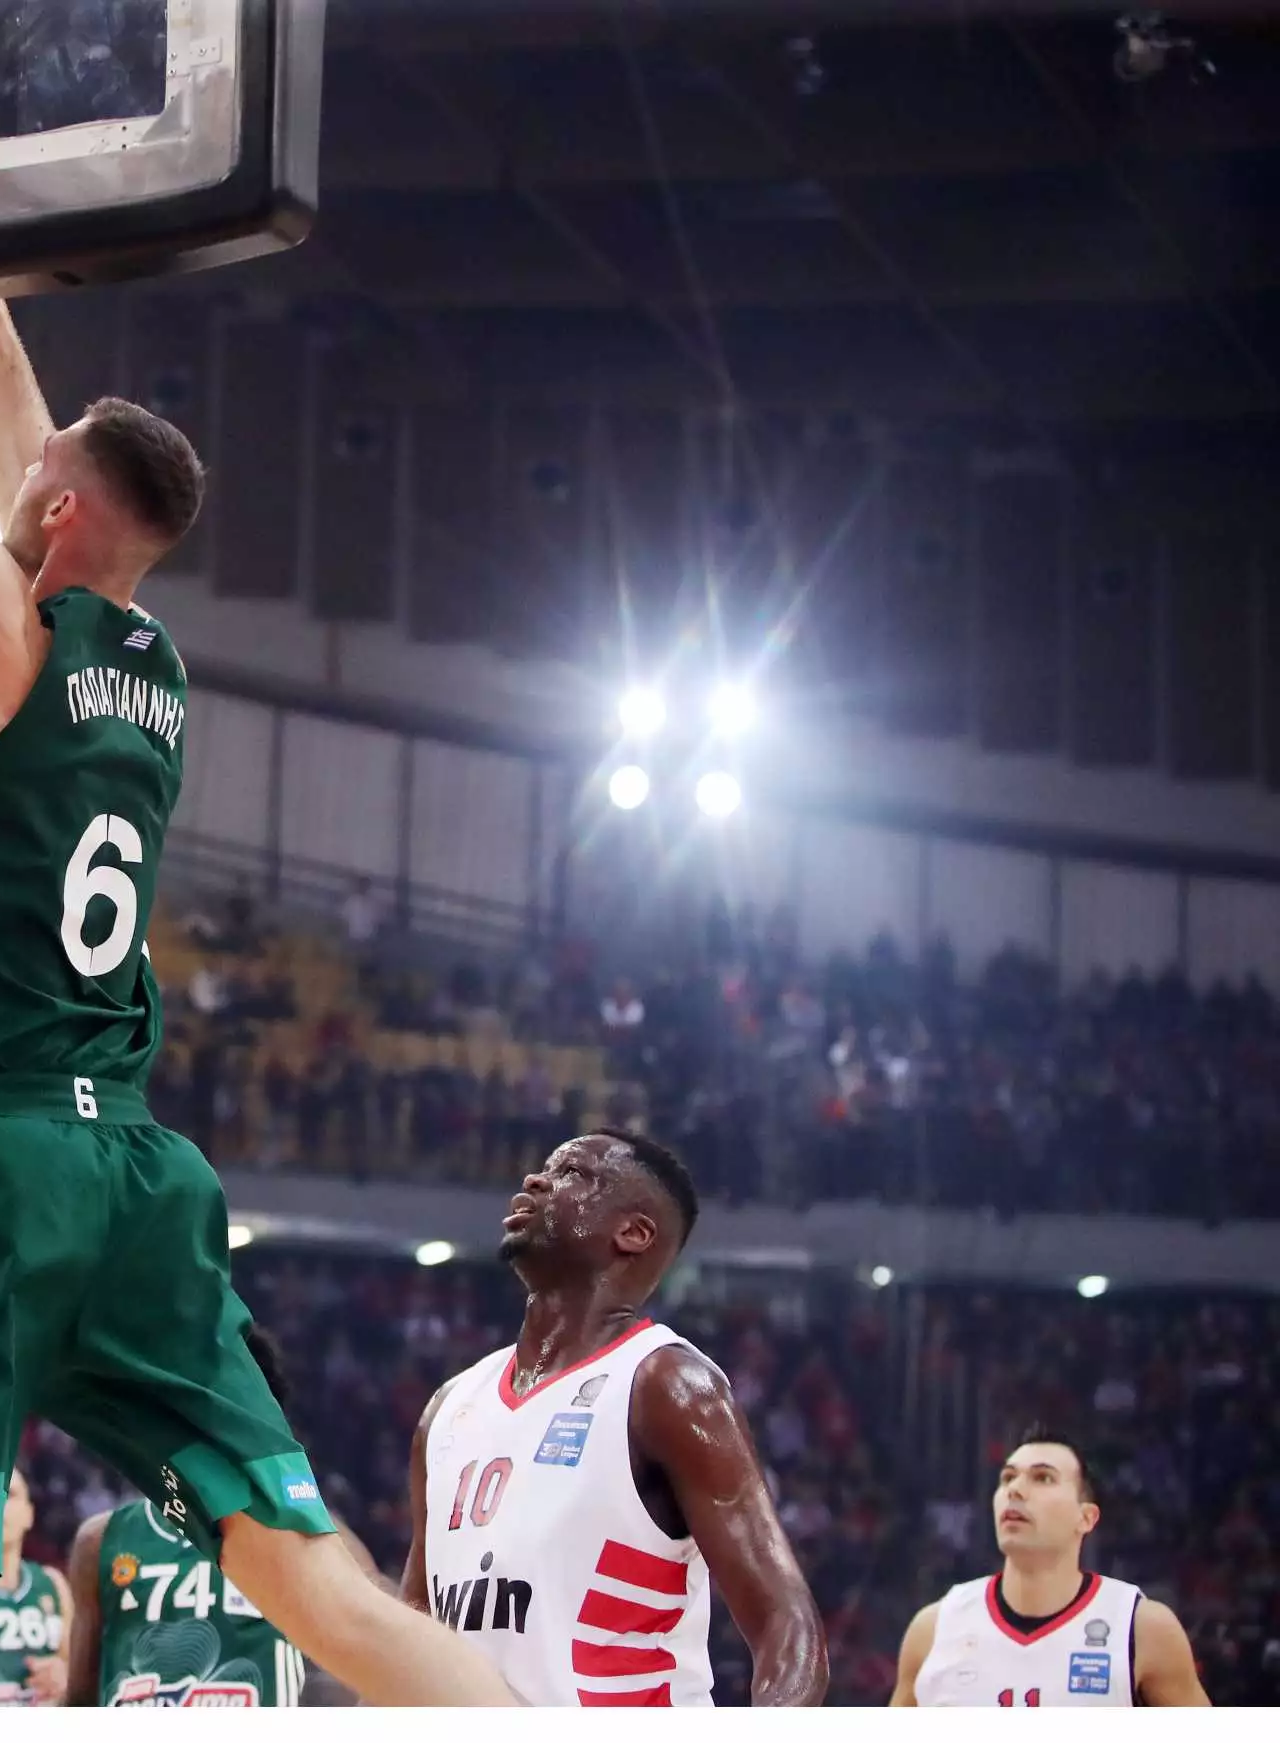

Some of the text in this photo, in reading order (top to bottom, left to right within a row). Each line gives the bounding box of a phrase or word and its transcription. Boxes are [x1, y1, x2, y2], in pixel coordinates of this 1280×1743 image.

[61, 813, 143, 977] 6
[73, 1076, 98, 1119] 6
[448, 1456, 514, 1531] 10
[140, 1560, 217, 1622] 74
